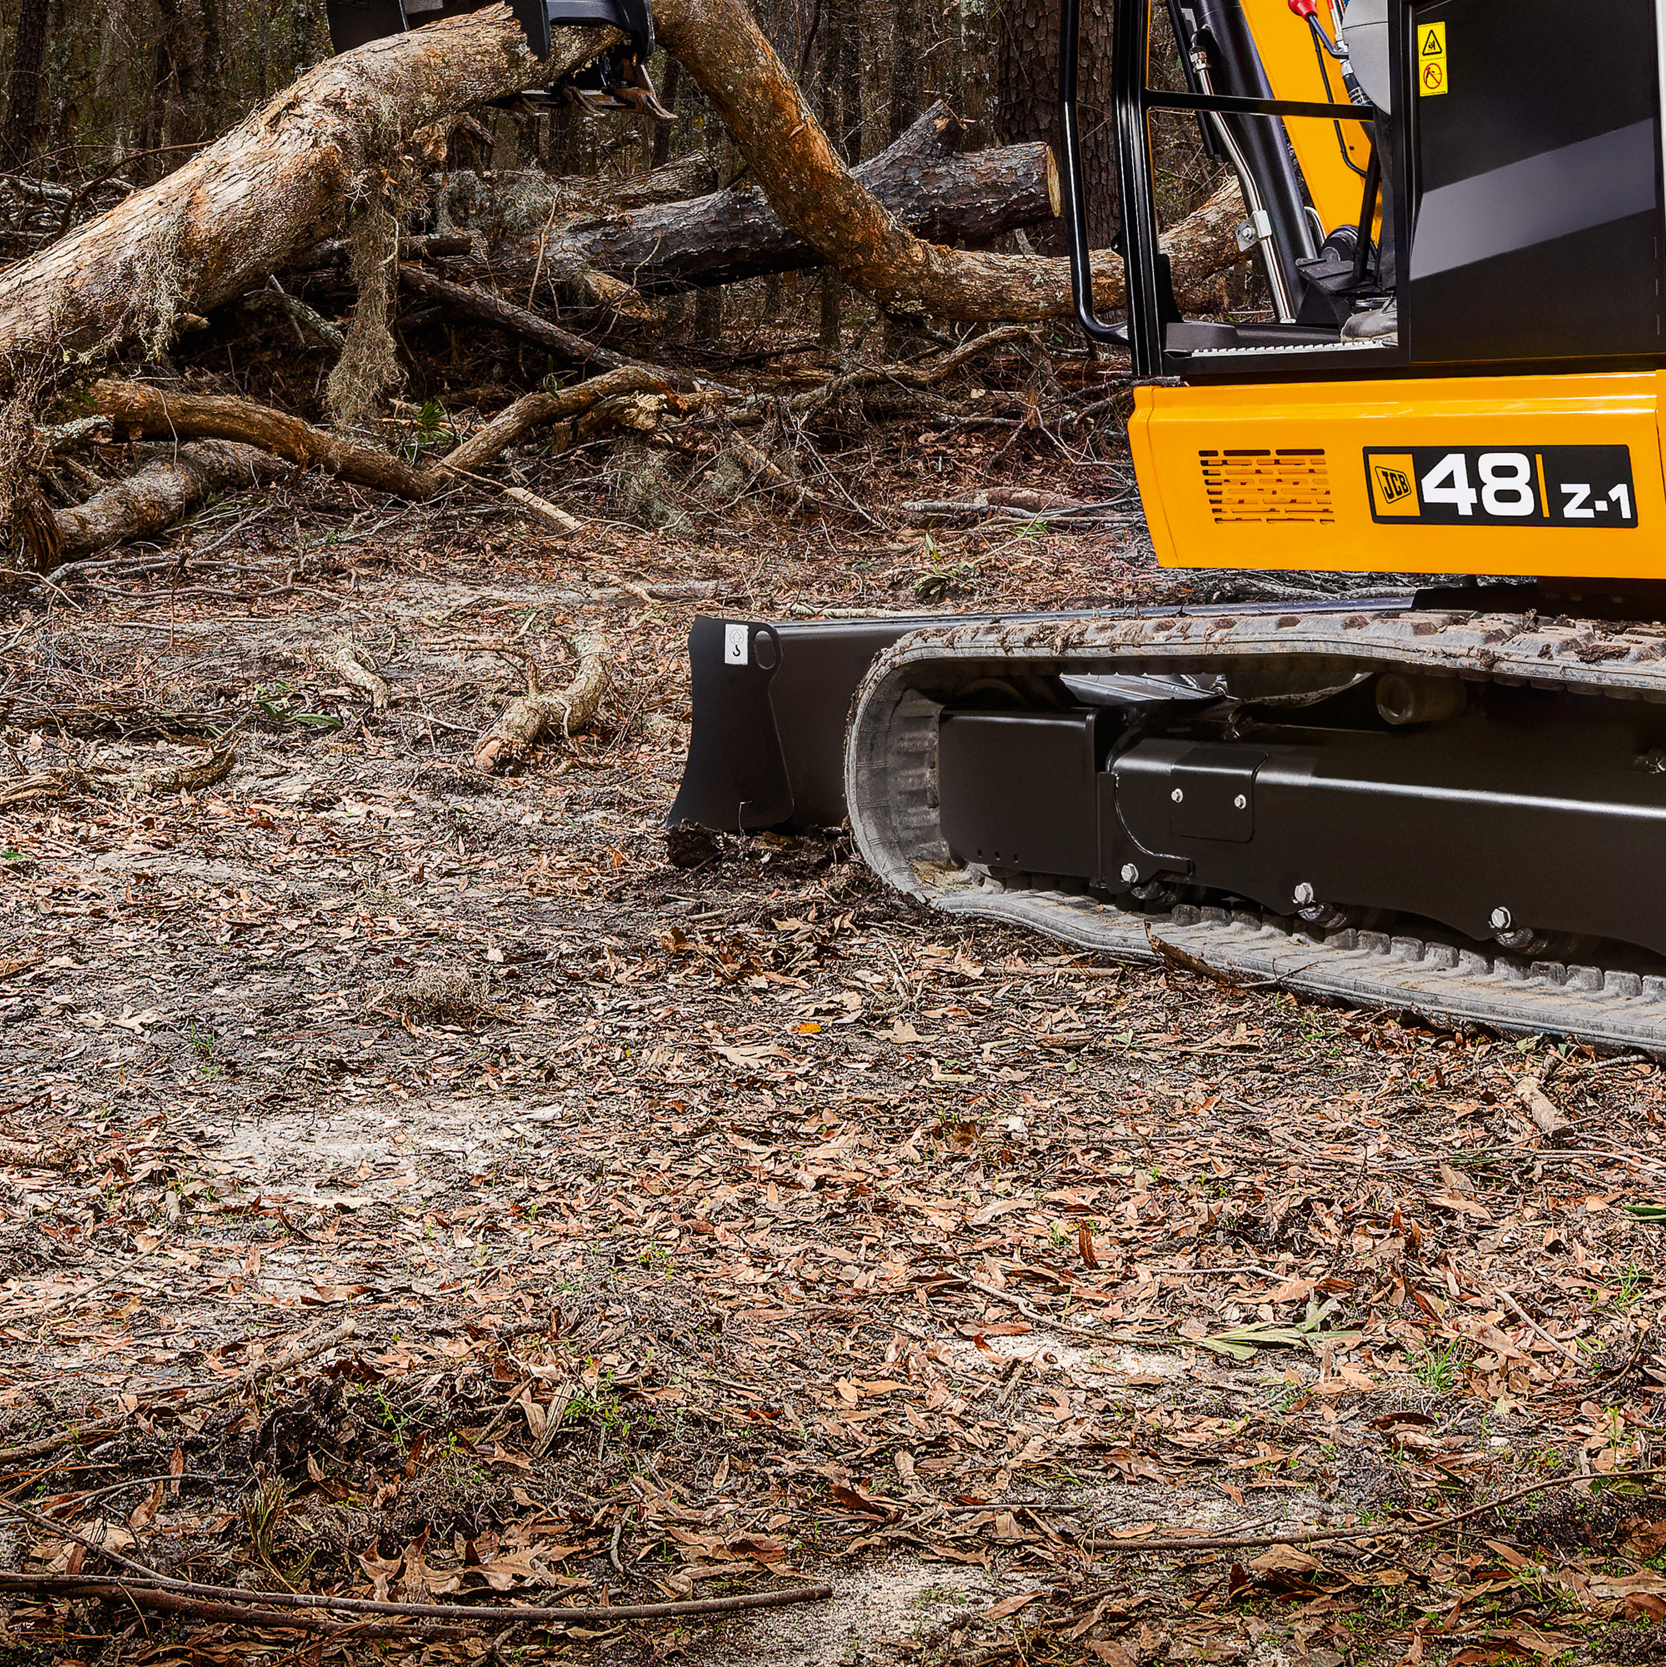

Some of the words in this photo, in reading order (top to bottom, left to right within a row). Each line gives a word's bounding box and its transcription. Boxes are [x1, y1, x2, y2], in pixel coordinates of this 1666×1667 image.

[1382, 470, 1410, 500] JCB
[1421, 452, 1535, 516] 48
[1560, 483, 1632, 519] Z-1
